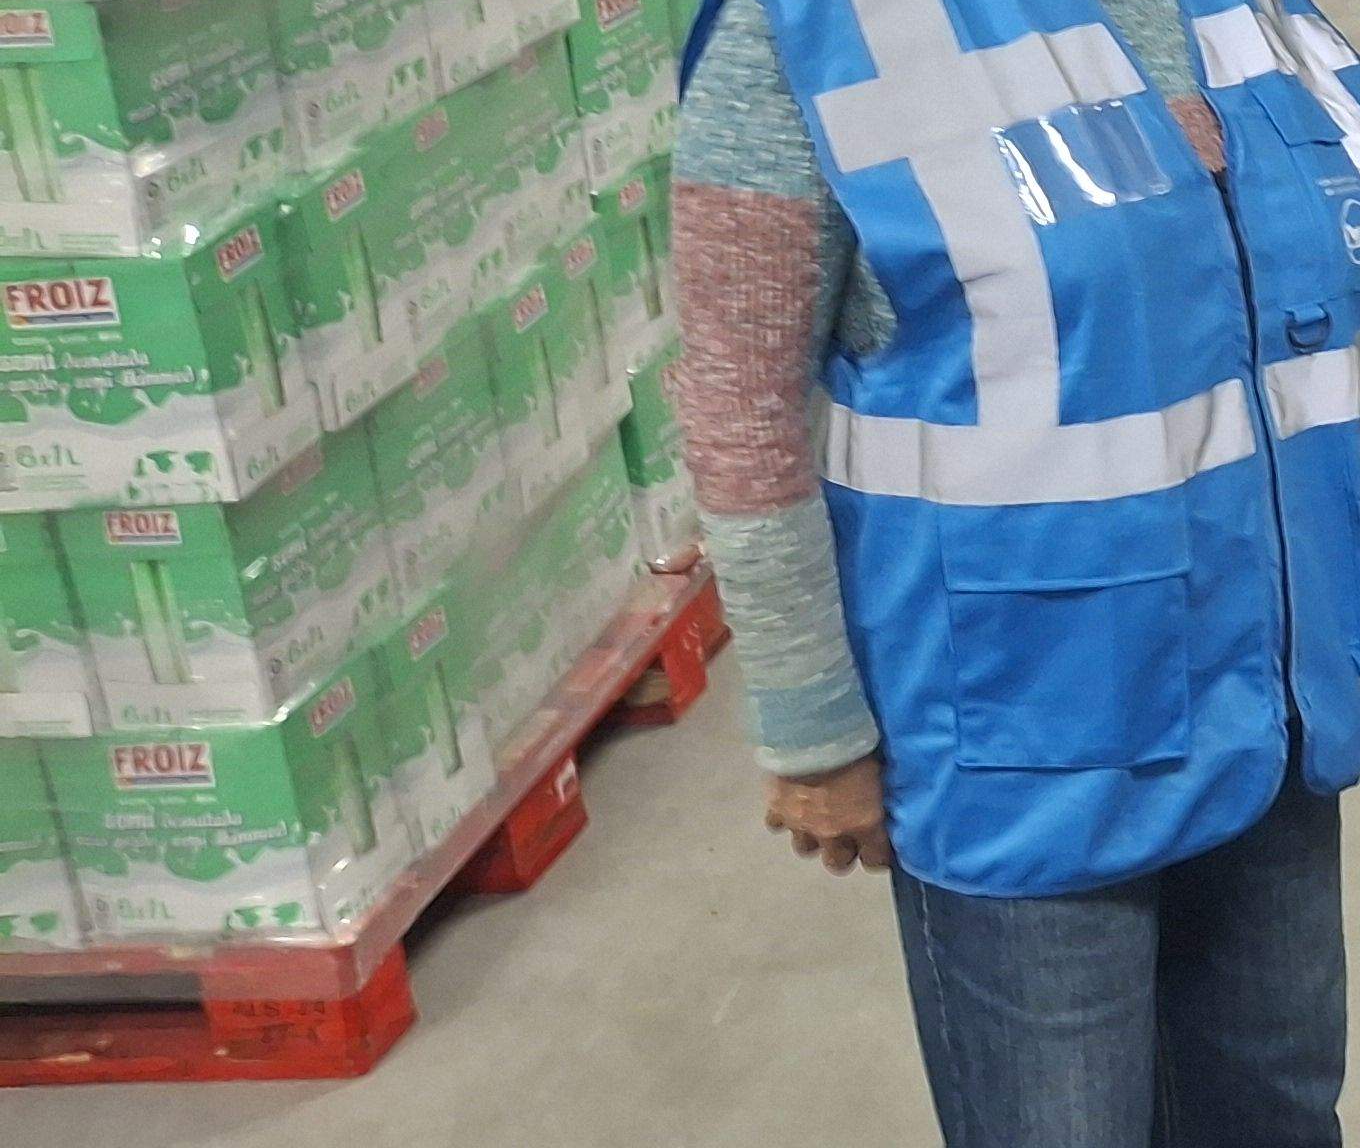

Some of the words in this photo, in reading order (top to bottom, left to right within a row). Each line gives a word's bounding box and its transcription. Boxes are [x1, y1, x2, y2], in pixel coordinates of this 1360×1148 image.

[6, 280, 111, 313] FROIZ
[107, 512, 176, 536] FROIZ
[114, 744, 209, 775] FROIZ
